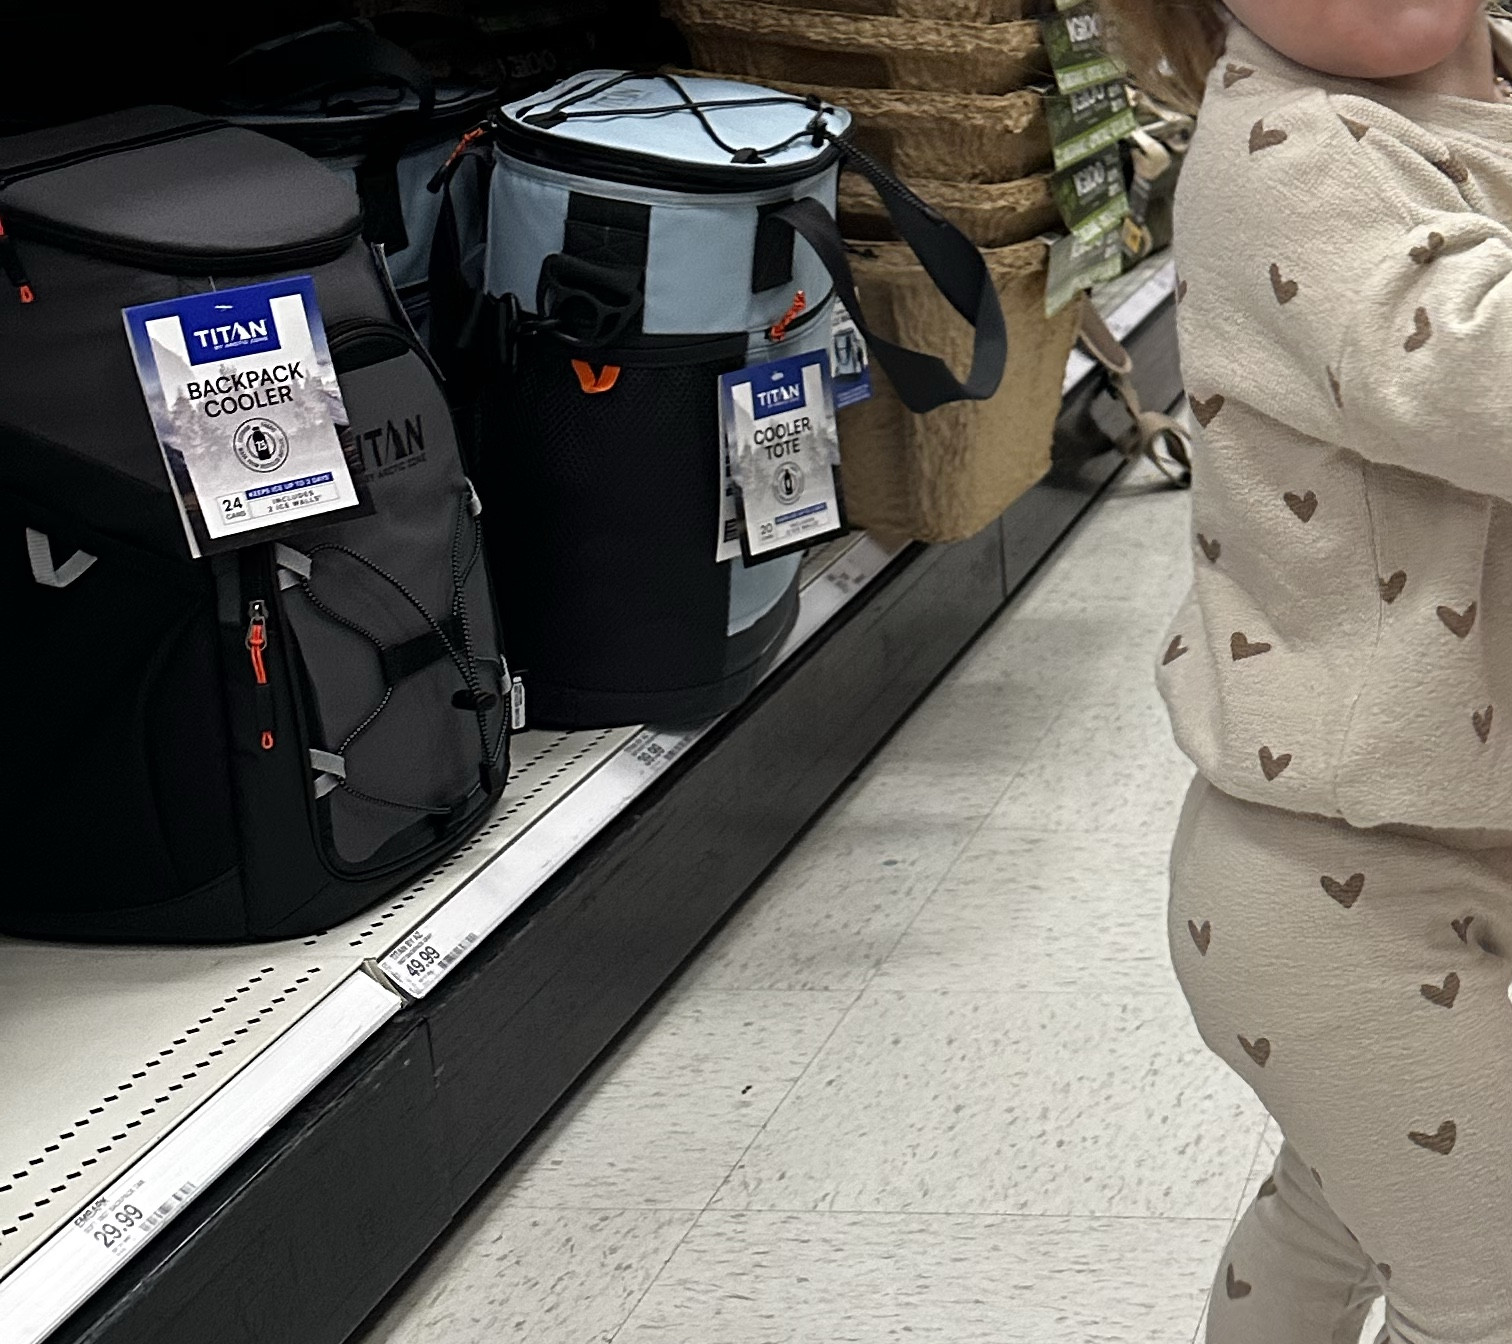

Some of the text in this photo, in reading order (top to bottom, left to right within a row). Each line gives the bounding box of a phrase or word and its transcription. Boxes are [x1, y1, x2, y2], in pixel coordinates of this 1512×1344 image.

[193, 319, 267, 348] TITAN
[187, 361, 304, 400] BACKPACK
[204, 385, 293, 417] COOLER
[757, 384, 799, 406] TITAN
[754, 417, 812, 445] COOLER
[764, 437, 801, 460] TOTE
[222, 496, 243, 512] 24
[272, 490, 315, 504] INCLUDES
[406, 945, 440, 976] 49.99
[94, 1204, 143, 1248] 29.99
